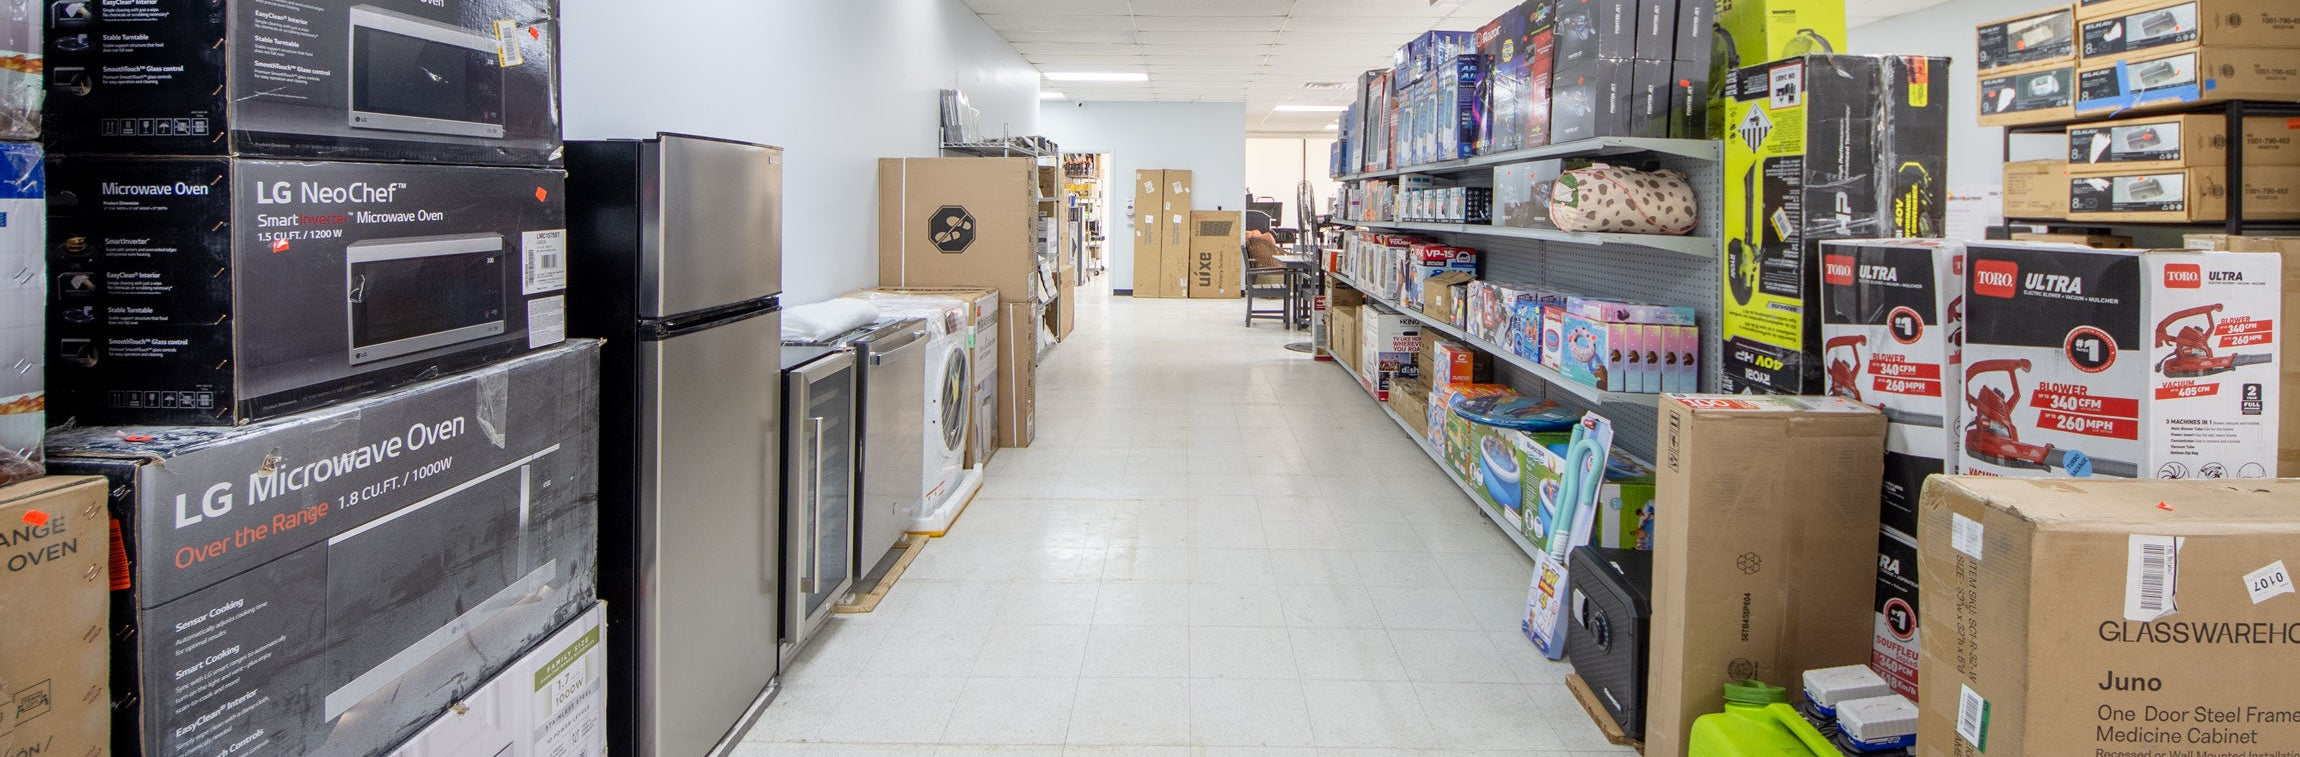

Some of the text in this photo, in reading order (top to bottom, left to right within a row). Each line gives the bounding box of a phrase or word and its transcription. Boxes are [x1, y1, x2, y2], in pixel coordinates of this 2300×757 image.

[288, 16, 308, 25] Interior
[255, 35, 300, 48] Stable Turntable
[2084, 42, 2093, 55] 8
[297, 66, 312, 74] Glass
[2071, 148, 2080, 160] 8
[102, 181, 209, 195] Microwave Oven
[257, 181, 292, 205] LG
[1895, 198, 1904, 227] 40V
[2071, 197, 2080, 210] 8
[356, 211, 415, 225] Microwave
[418, 209, 444, 222] Oven
[1835, 191, 1851, 236] HP
[257, 229, 343, 242] 1.5 CU.FT. 1200 W
[1425, 249, 1454, 258] VP-15
[1825, 262, 1898, 282] TORO ULTRA
[2167, 271, 2244, 283] TORO ULTRA
[1977, 271, 2082, 295] TORO ULTRA
[2089, 297, 2119, 305] MULCHER
[2220, 316, 2251, 325] BLOWER
[2228, 323, 2245, 335] 340
[2231, 334, 2249, 346] 260
[1734, 350, 1784, 371] 40V HP
[1872, 352, 1906, 363] BLOWER
[1744, 367, 1771, 386] RYOBI
[1880, 362, 1917, 376] 340 CFM
[1886, 380, 1926, 393] 260 MPH
[2039, 381, 2089, 396] BLOWER
[2162, 380, 2196, 391] VACUUM
[2178, 386, 2211, 397] 405 CFM
[2246, 385, 2257, 397] 2
[2050, 394, 2103, 411] 340 CFM
[2057, 414, 2114, 432] 260 MPH
[175, 416, 465, 529] LG Microwave Oven
[338, 456, 453, 510] 1.8 CU.FT. 1000W
[175, 500, 329, 570] Over the Range
[8, 538, 78, 573] OVEN
[1968, 560, 1977, 590] ITEM
[2253, 571, 2284, 592] 0107
[176, 598, 244, 633] Sensor Cooking
[176, 644, 241, 680] Smart Cooking
[1879, 656, 1914, 677] 340 PCM
[557, 671, 572, 692] 1.7
[2098, 670, 2162, 692] Juno
[227, 689, 259, 710] Interior
[556, 679, 584, 707] 1000W
[2097, 704, 2300, 723] One Door Steel Frame
[230, 728, 265, 753] Controls
[2096, 725, 2257, 745] Medicine Cabinet
